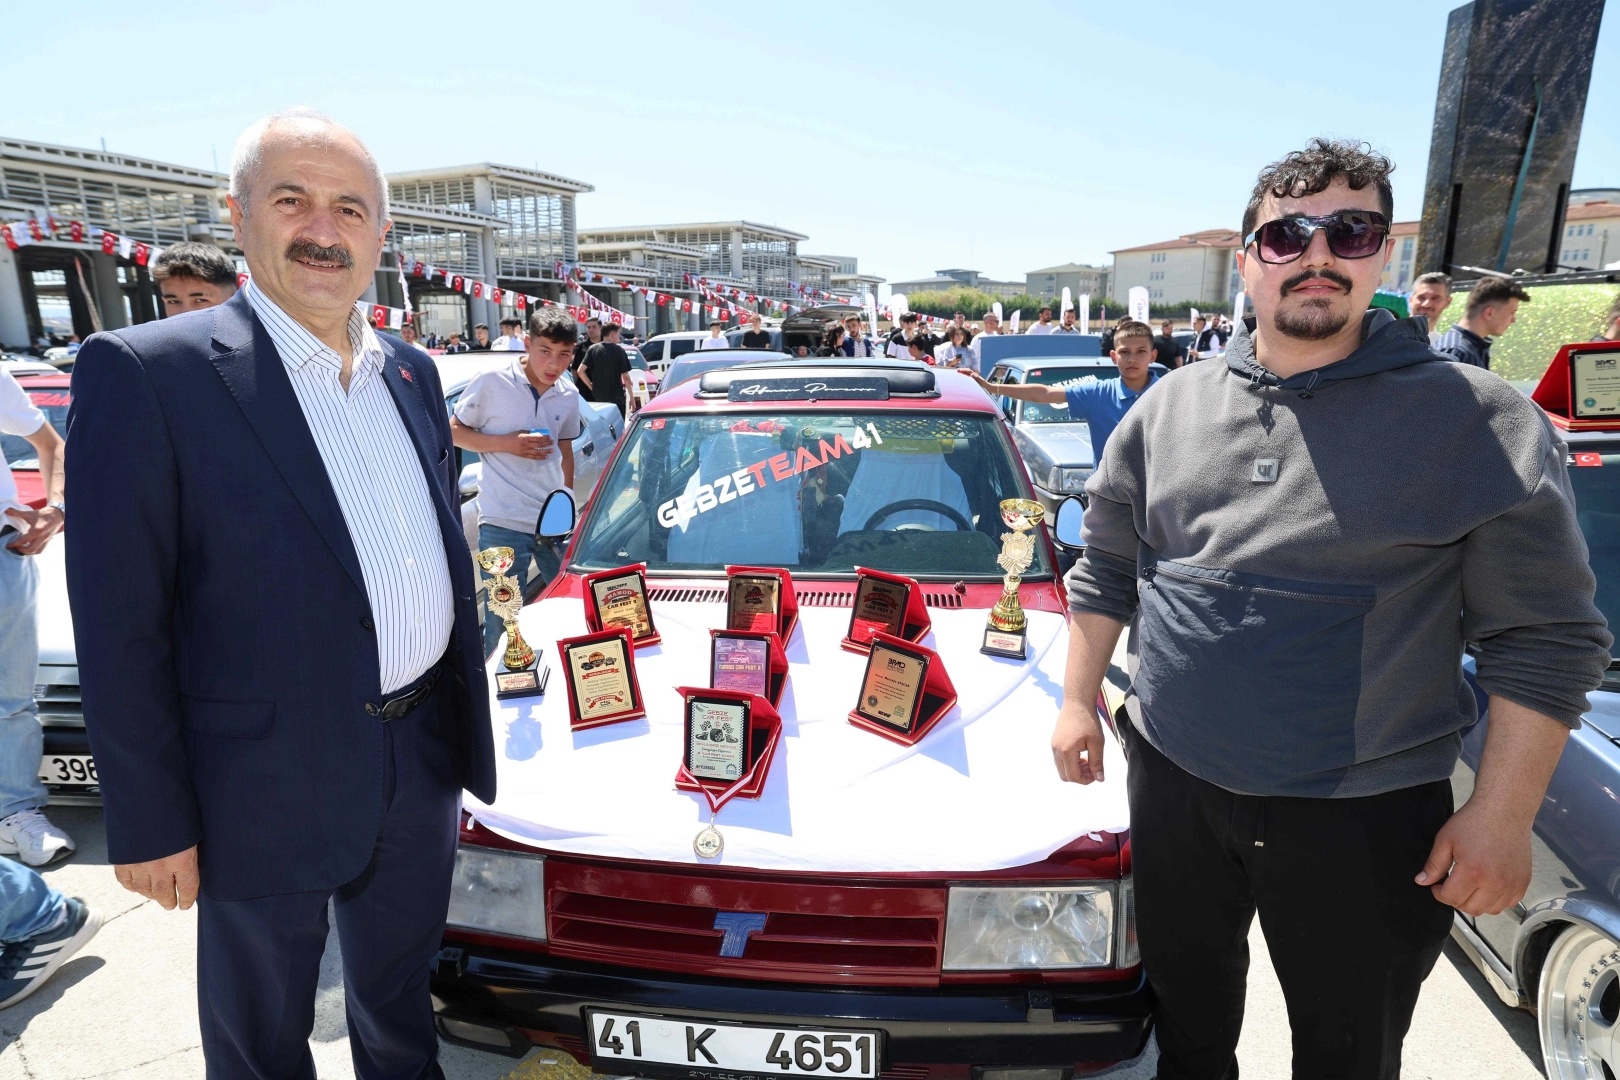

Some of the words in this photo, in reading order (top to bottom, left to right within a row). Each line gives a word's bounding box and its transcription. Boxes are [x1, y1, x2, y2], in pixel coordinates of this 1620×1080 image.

[599, 1018, 642, 1057] 41
[685, 1025, 718, 1064] K
[765, 1032, 871, 1075] 4651
